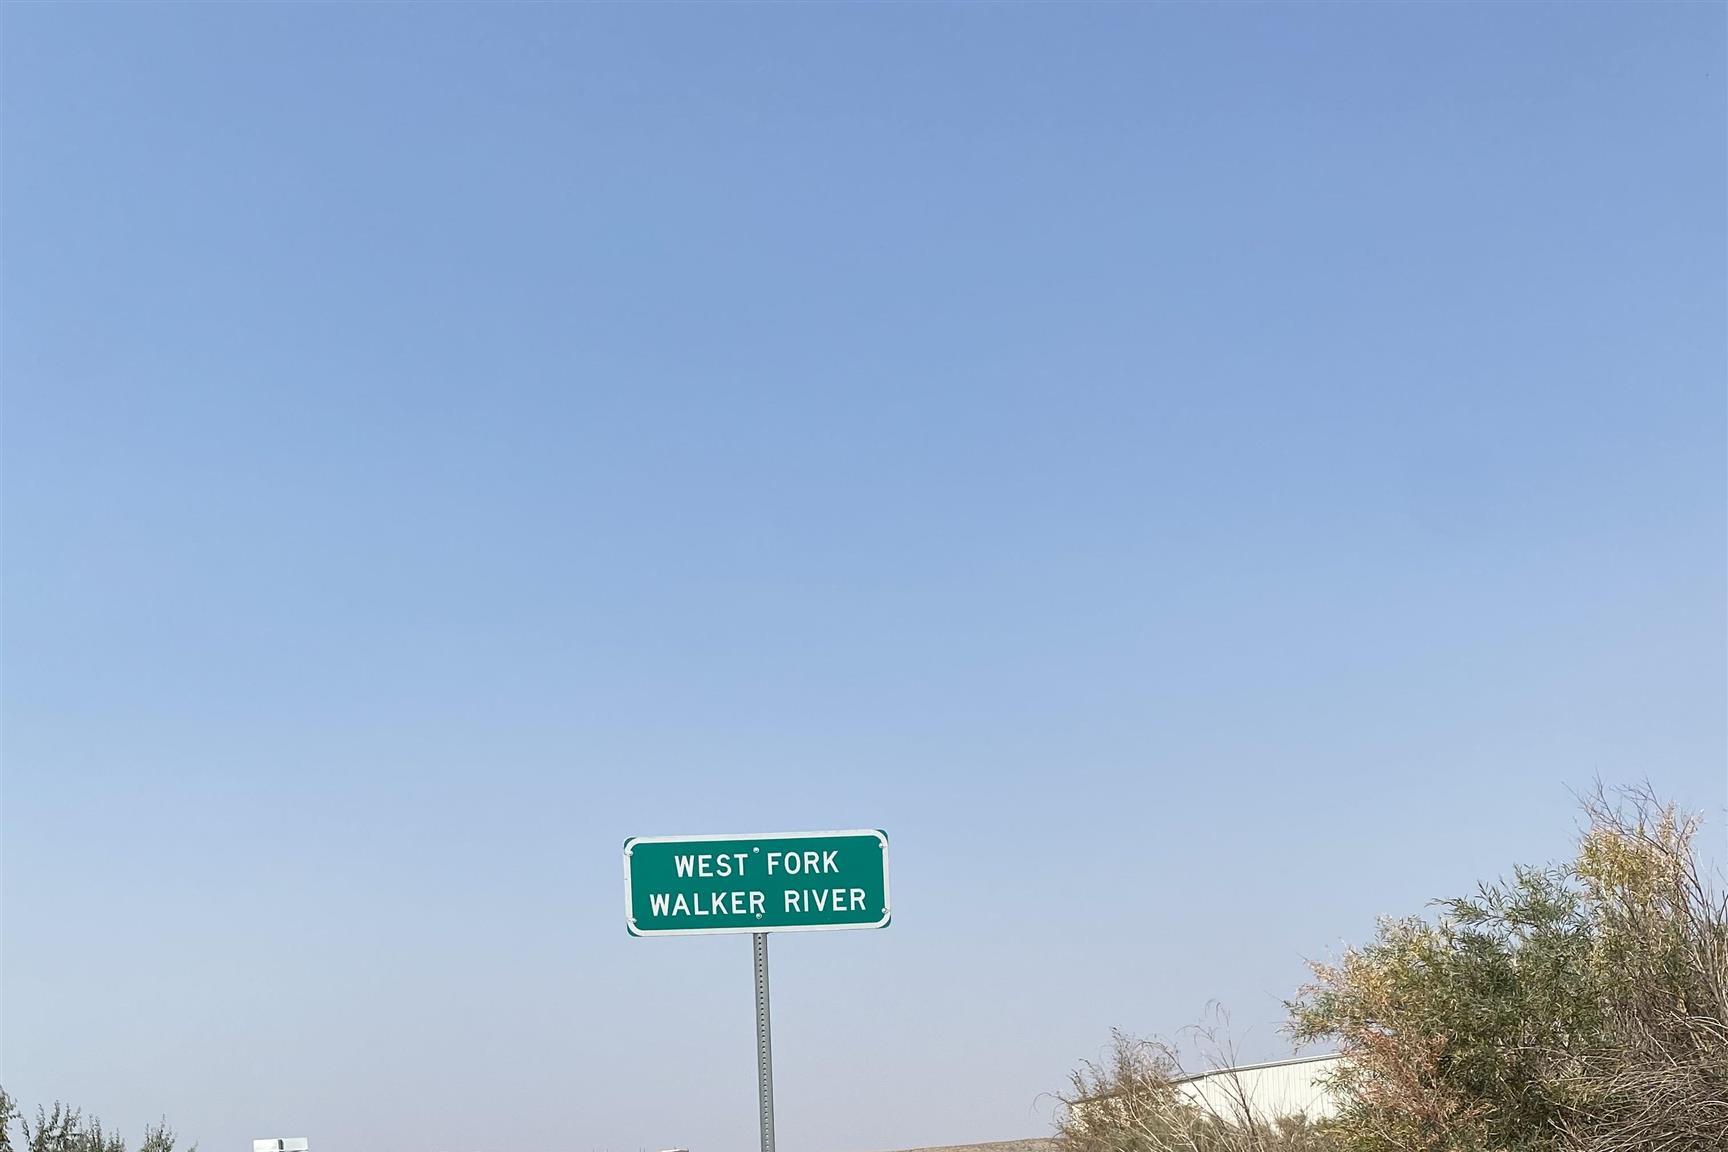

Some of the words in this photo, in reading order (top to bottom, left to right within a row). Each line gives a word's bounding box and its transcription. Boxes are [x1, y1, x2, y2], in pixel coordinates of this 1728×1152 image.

[674, 853, 748, 877] WEST
[767, 850, 839, 876] FORK
[649, 891, 766, 917] WALKER
[783, 888, 866, 913] RIVER
